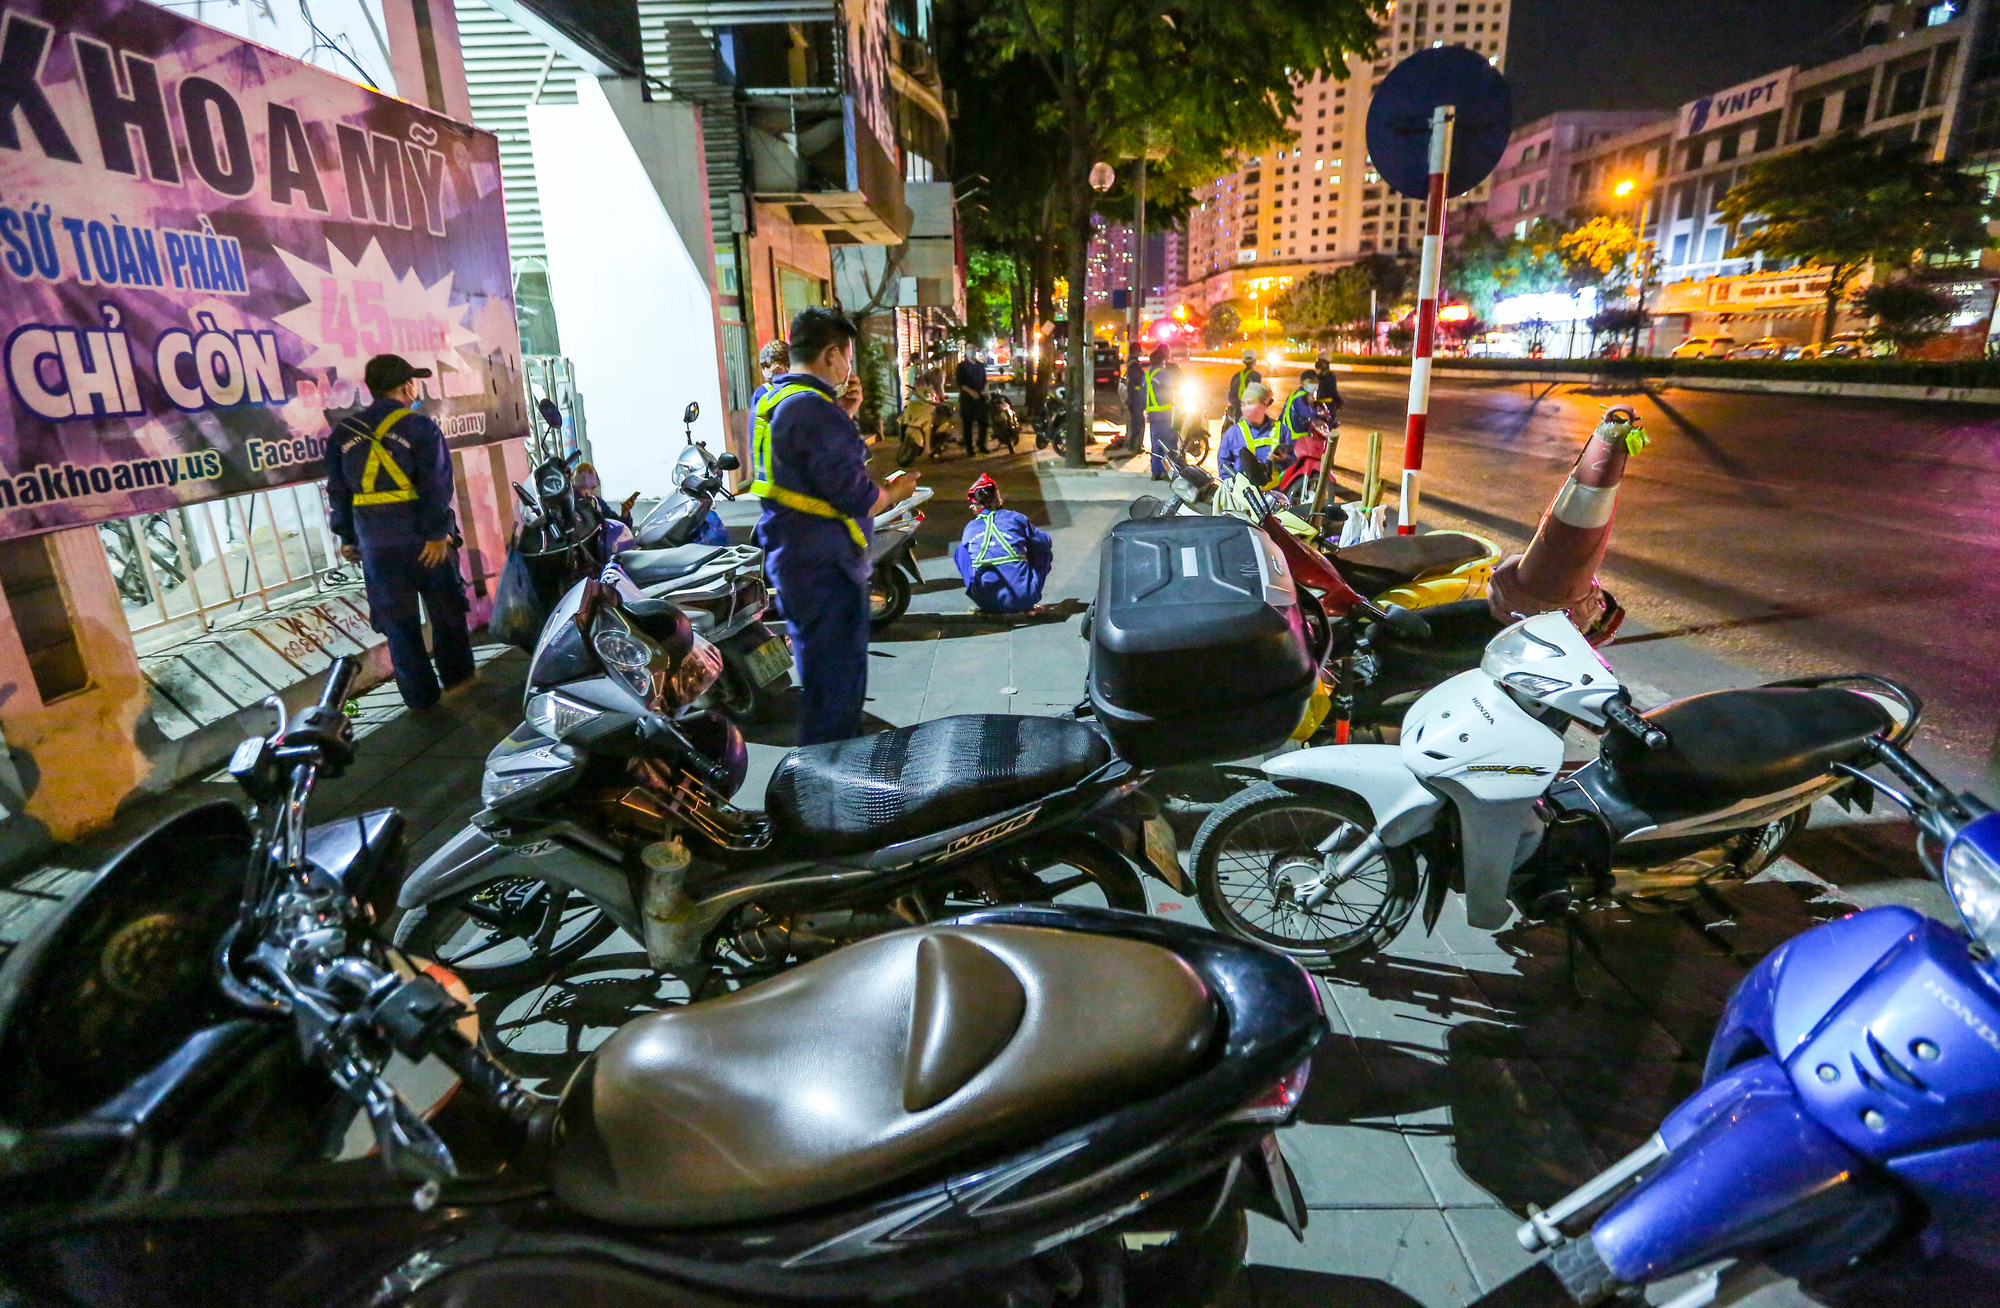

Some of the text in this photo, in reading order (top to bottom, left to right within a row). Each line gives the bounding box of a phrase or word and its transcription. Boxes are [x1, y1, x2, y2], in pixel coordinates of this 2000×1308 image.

[0, 12, 446, 237] KHOA MỸ
[1717, 80, 1779, 118] VNPT
[0, 202, 248, 294] SỨ TOÀN PHẦN
[319, 277, 393, 358] 45
[5, 301, 289, 421] CHỈ CÒN
[249, 435, 329, 469] Facebo
[1472, 697, 1495, 725] HONDA
[1922, 979, 2000, 1051] HOND
